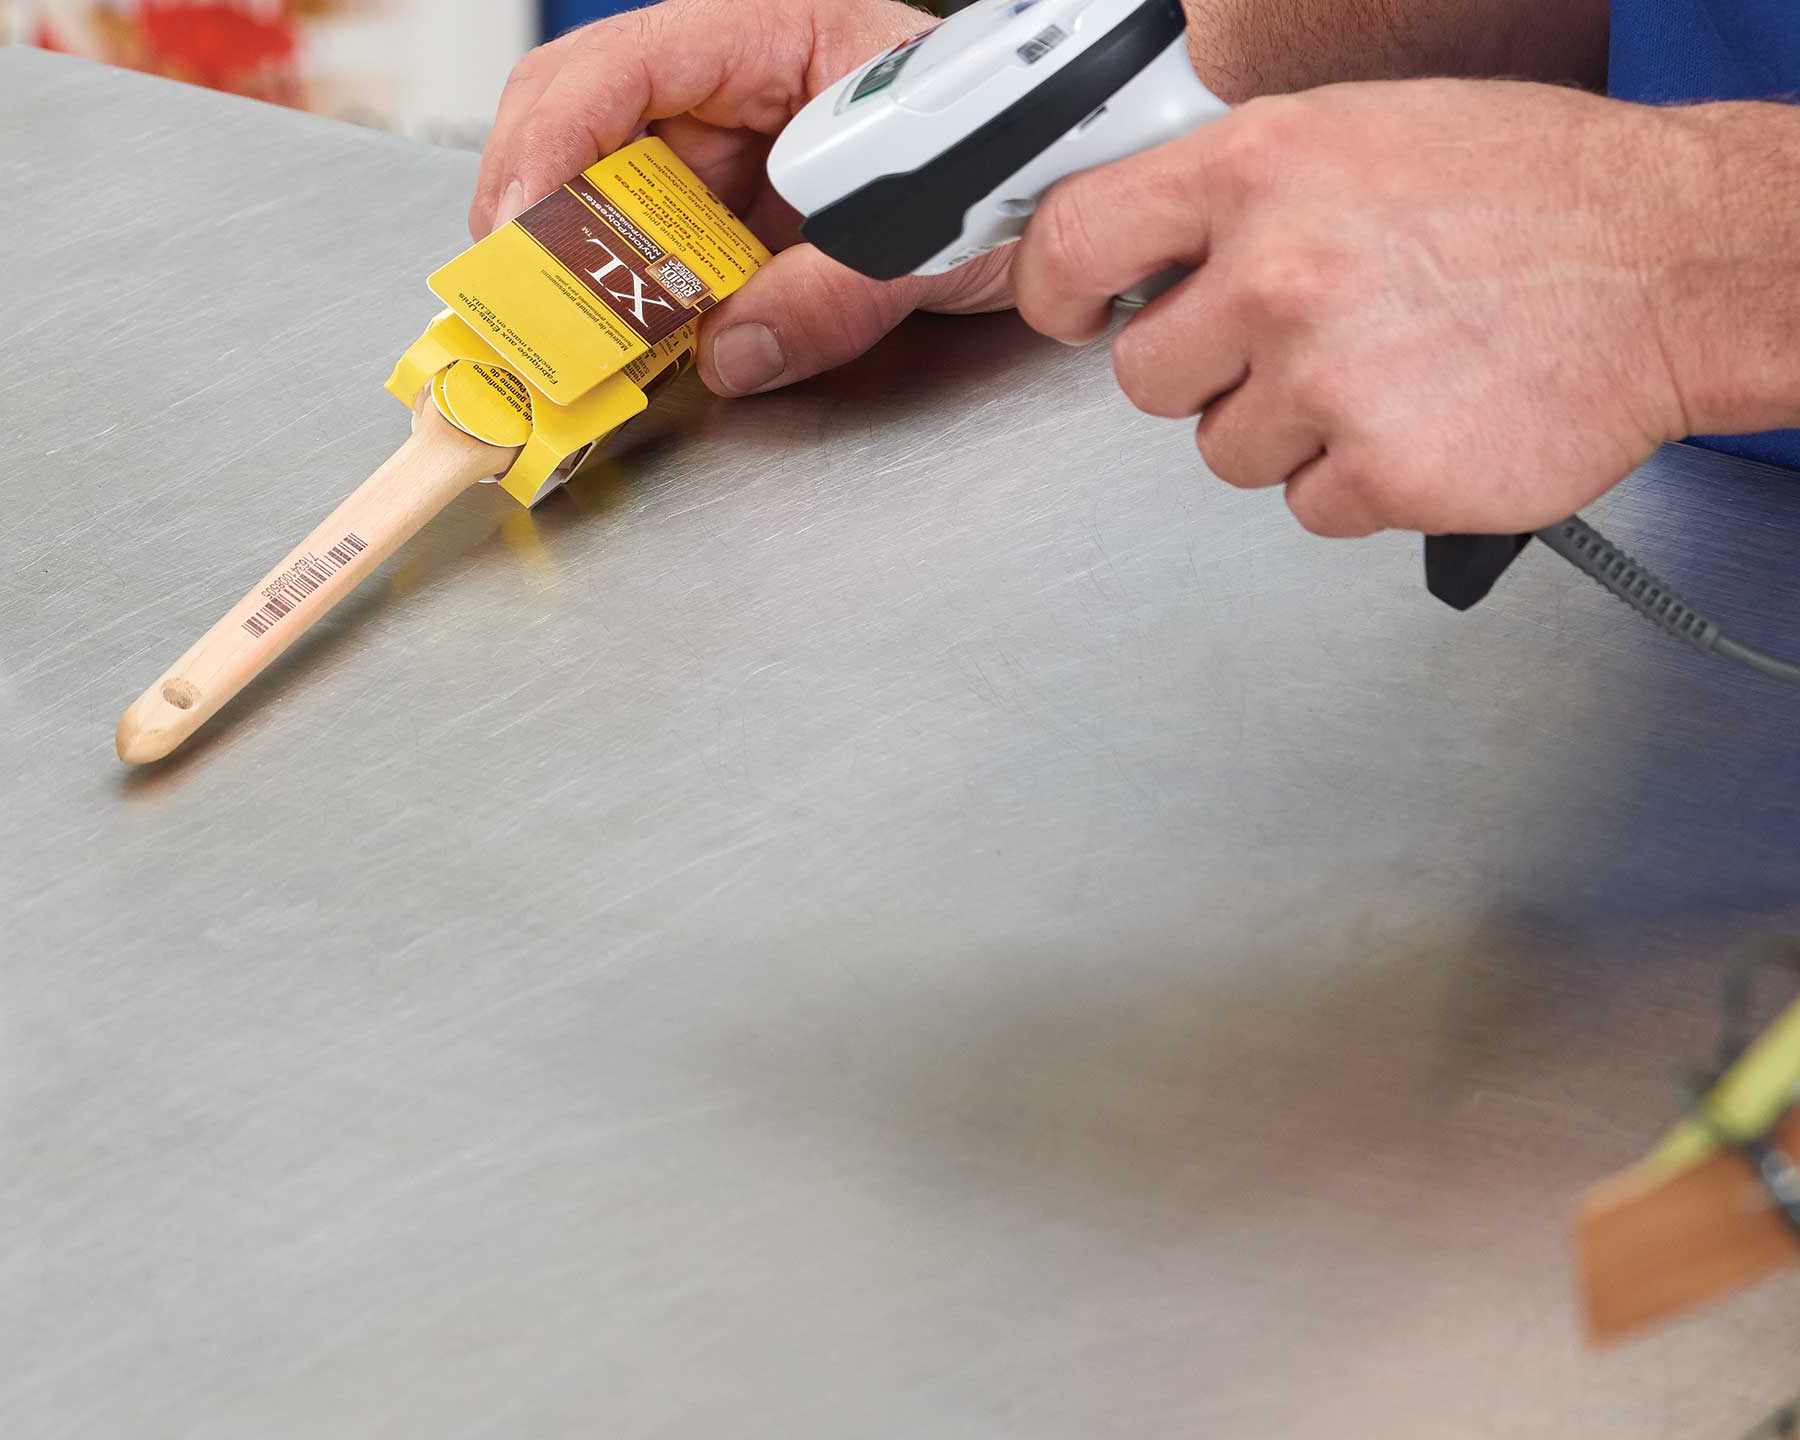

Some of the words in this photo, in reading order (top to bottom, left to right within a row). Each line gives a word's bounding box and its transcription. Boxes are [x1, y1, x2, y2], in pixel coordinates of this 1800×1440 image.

[626, 159, 655, 188] tintes
[612, 173, 673, 229] peintures
[636, 187, 692, 239] teintures
[662, 194, 705, 235] pinturas
[579, 189, 657, 261] Nylon/Polyester
[602, 201, 662, 256] Nylon/Poliéster
[641, 208, 660, 227] pour
[658, 225, 687, 252] Conçue
[674, 259, 702, 286] MEDIA
[684, 241, 727, 281] Toutes
[716, 245, 747, 275] Todas
[658, 261, 696, 298] RIGIDE
[666, 257, 702, 293] DUREZA
[455, 291, 501, 333] États-Unis
[574, 300, 599, 323] peinture
[596, 321, 606, 330] de
[499, 331, 517, 347] aux
[505, 327, 528, 347] mano
[604, 329, 629, 351] Matériel
[488, 367, 500, 379] de
[515, 345, 558, 384] Fabriquée
[530, 351, 557, 375] Hecha
[470, 363, 508, 397] confiance
[497, 375, 528, 403] gamme
[504, 394, 523, 412] faire
[521, 410, 533, 422] de
[260, 551, 319, 600] 716341008505
